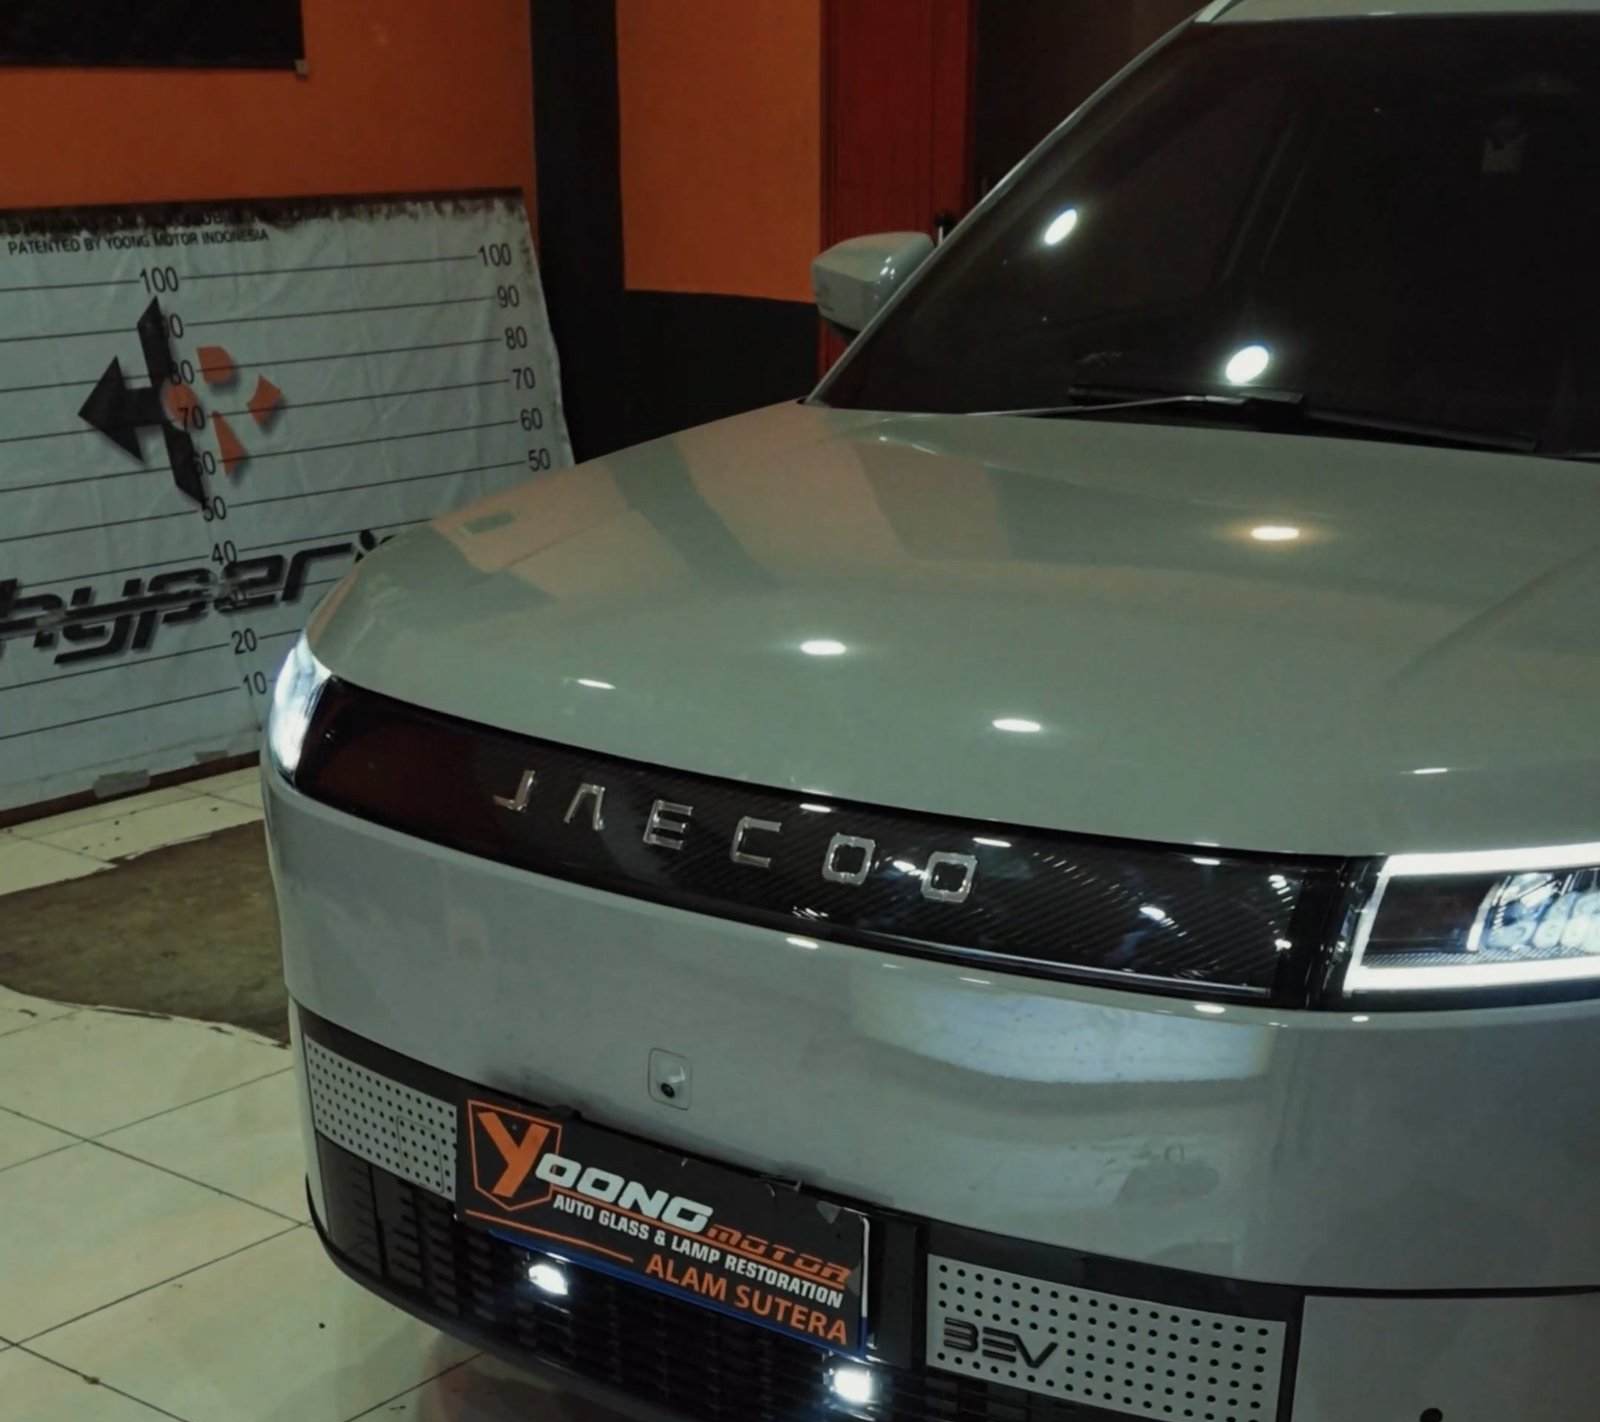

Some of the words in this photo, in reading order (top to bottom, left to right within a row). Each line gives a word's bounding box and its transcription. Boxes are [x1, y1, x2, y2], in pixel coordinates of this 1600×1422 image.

[8, 237, 81, 256] PATENTED
[84, 235, 101, 252] BY
[105, 232, 151, 251] YOONG
[153, 231, 199, 248] MOTOR
[202, 228, 270, 246] INDONESIA
[479, 243, 512, 267] 100
[139, 265, 180, 294] 100
[496, 285, 519, 308] 90
[504, 325, 528, 349] 80
[511, 366, 535, 390] 70
[177, 404, 206, 432] 70
[519, 407, 543, 431] 60
[527, 448, 551, 472] 50
[203, 495, 227, 522] 50
[211, 540, 237, 566] 40
[231, 627, 257, 655] 20
[242, 671, 268, 696] 10
[493, 769, 980, 904] JAECOO
[477, 1111, 714, 1234] YOONG
[552, 1193, 595, 1221] AUTO
[599, 1209, 651, 1240] GLASS
[653, 1230, 666, 1246] &
[671, 1235, 721, 1266] LAMP
[725, 1254, 844, 1310] RESTORATION
[644, 1253, 727, 1302] ALAM
[735, 1285, 848, 1346] SUTERA
[943, 1316, 1059, 1369] BEV
